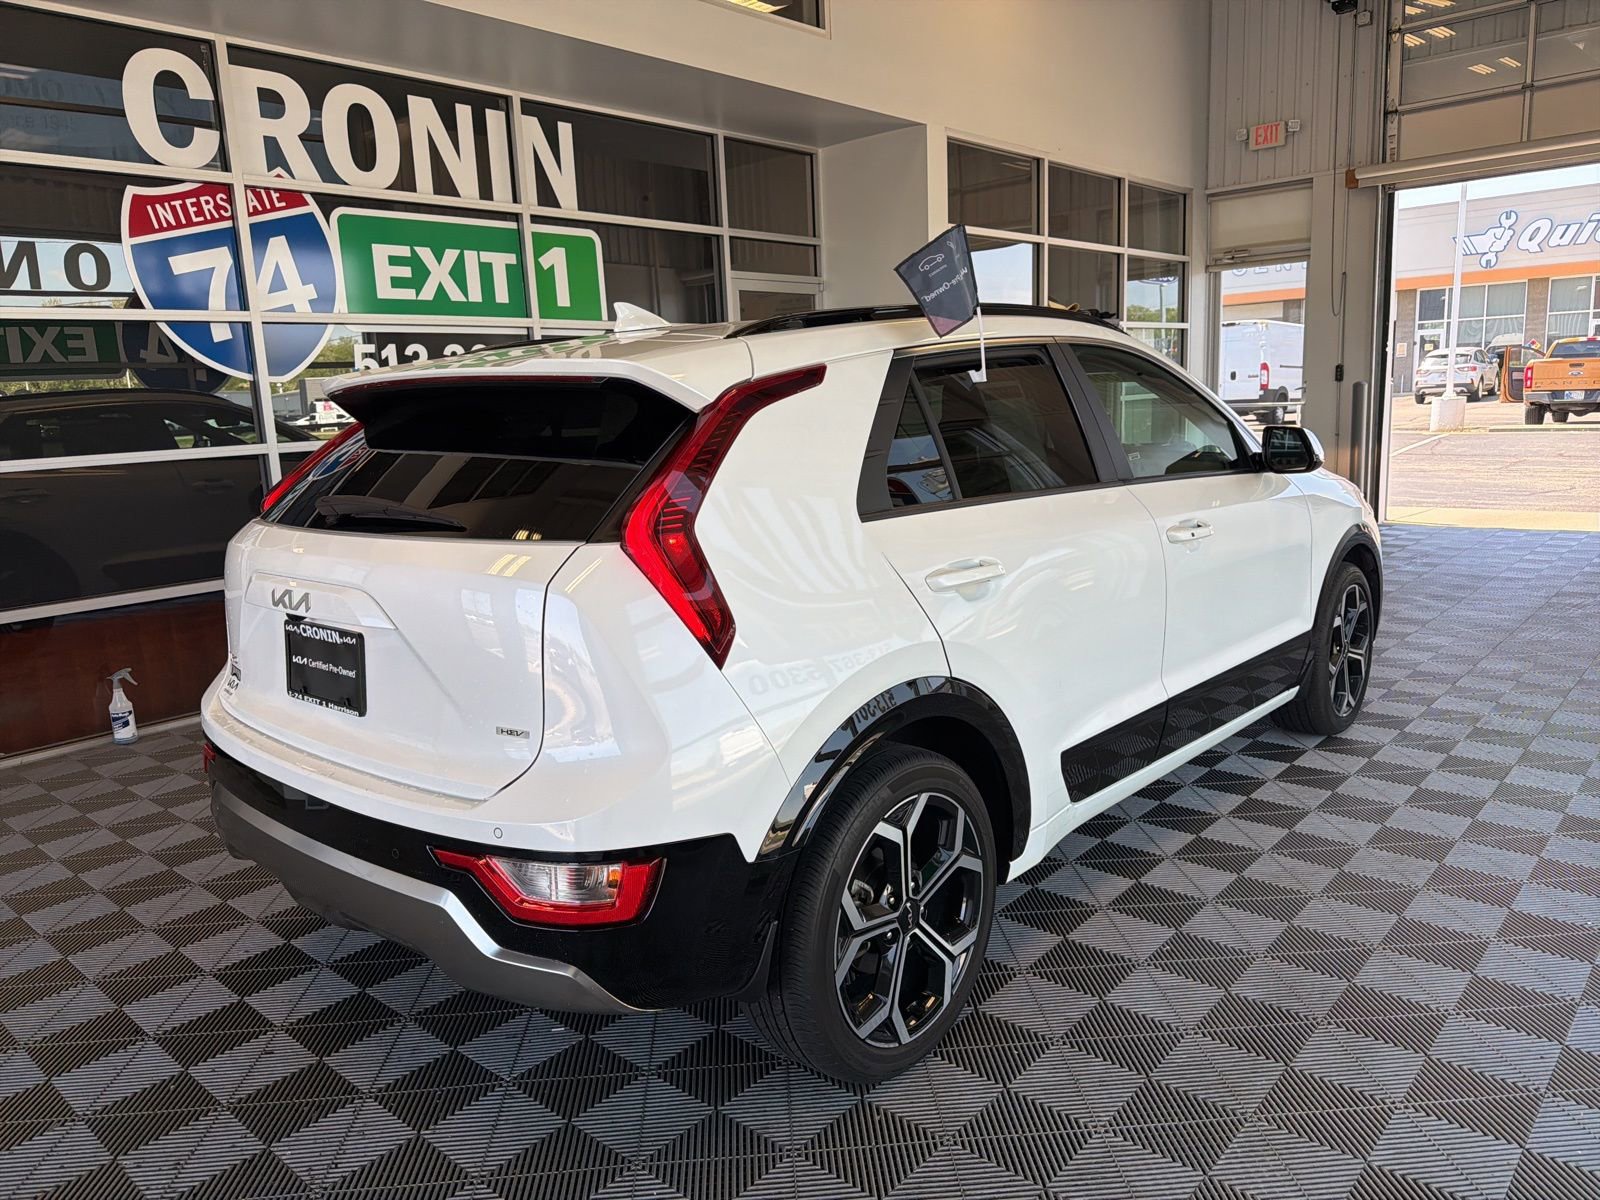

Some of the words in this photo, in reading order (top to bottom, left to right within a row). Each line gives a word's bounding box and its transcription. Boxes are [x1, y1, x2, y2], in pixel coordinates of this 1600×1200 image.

[121, 48, 578, 210] CRONIN
[1255, 122, 1280, 146] EXIT
[146, 188, 287, 230] INTERSATE
[371, 243, 517, 305] EXIT
[537, 246, 571, 308] 1
[167, 235, 318, 344] 74
[271, 588, 311, 613] KIA
[300, 624, 341, 645] CRONIN
[308, 658, 329, 671] Certified
[329, 663, 356, 678] Pre-Owned
[304, 696, 320, 705] EXIT
[328, 703, 359, 717] Harrison
[500, 728, 525, 737] HEV
